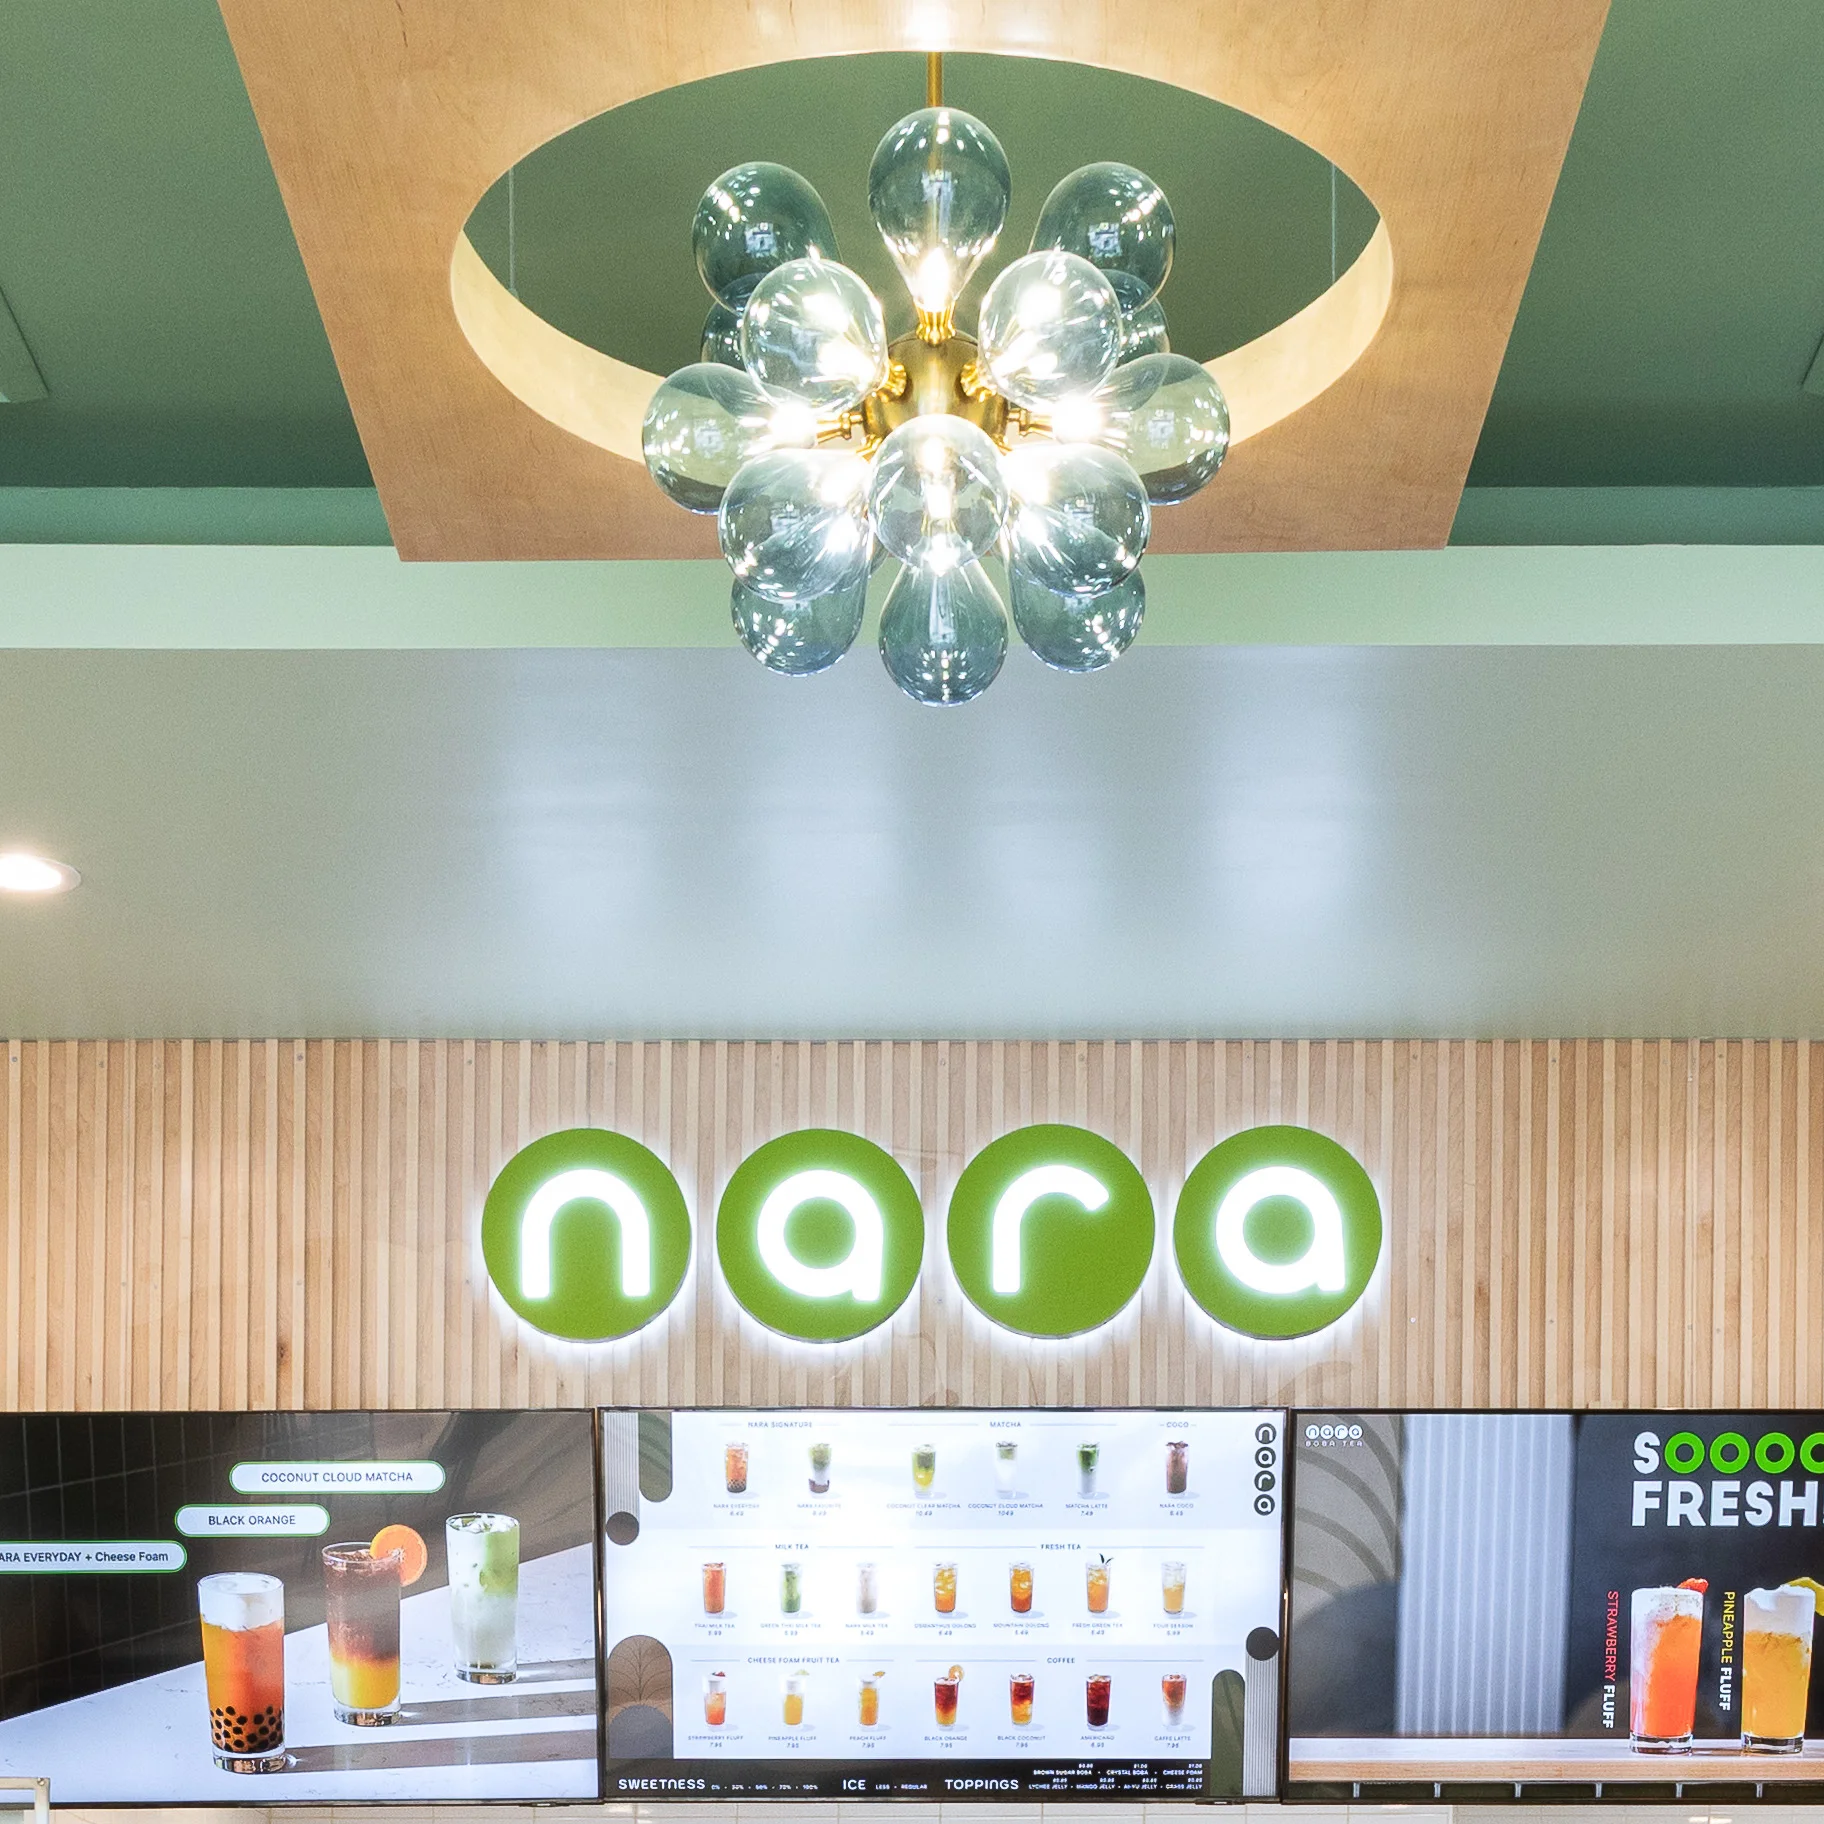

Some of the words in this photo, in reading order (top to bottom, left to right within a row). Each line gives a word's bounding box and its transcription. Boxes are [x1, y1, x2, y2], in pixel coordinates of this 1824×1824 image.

[504, 1146, 1364, 1318] nara
[1307, 1426, 1362, 1438] nara
[1255, 1424, 1276, 1514] nara
[261, 1472, 320, 1483] COCONUT
[322, 1472, 362, 1483] CLOUD
[365, 1471, 413, 1482] MATCHA
[208, 1515, 245, 1526] BLACK
[248, 1514, 296, 1526] ORANGE
[24, 1552, 81, 1563] EVERYDAY
[95, 1550, 136, 1563] Cheese
[138, 1551, 169, 1562] Foam
[1721, 1591, 1736, 1664] PINEAPPLE
[1604, 1590, 1619, 1682] STRAWBERRY
[1719, 1667, 1732, 1712] FLUFF
[1602, 1684, 1616, 1729] FLUFF
[618, 1779, 706, 1790] SWEETNESS
[842, 1780, 866, 1790] ICE
[944, 1779, 1019, 1790] TOPPINGS
